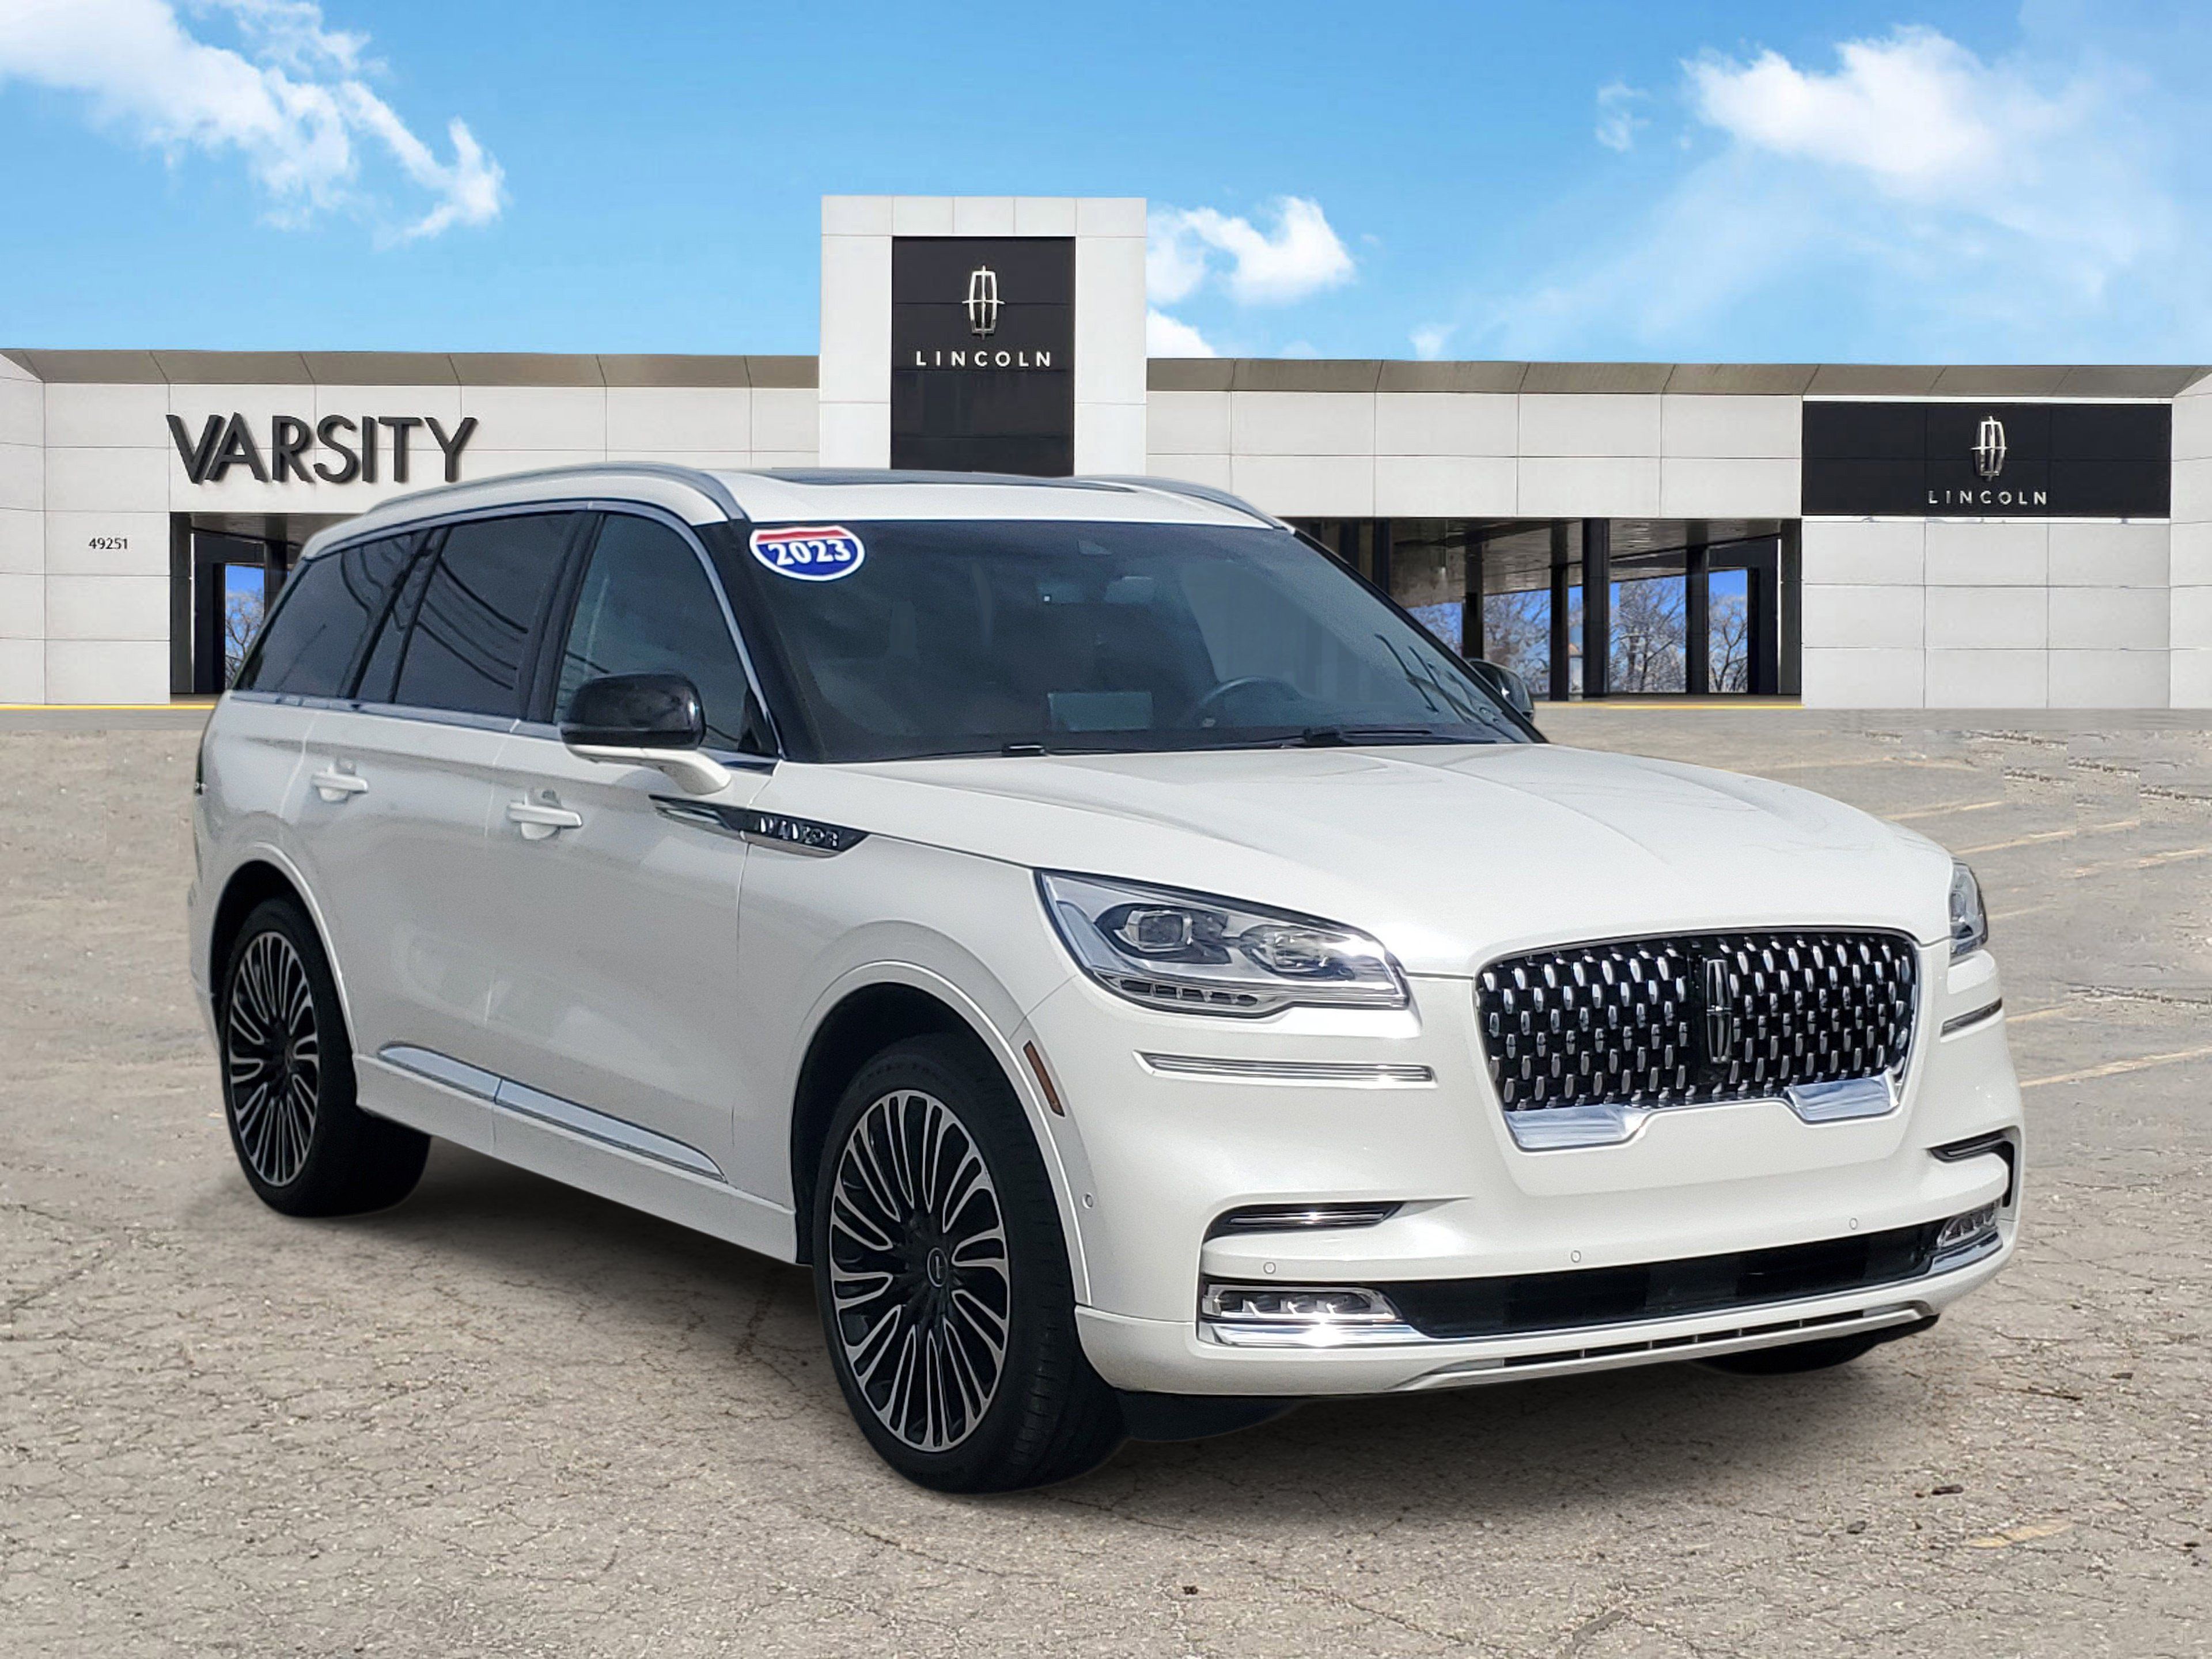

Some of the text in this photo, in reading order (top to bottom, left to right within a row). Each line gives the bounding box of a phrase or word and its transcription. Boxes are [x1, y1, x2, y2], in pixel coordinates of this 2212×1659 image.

[915, 350, 1051, 368] LINCOLN
[166, 412, 479, 485] VARSITY
[1927, 490, 2047, 506] LINCOLN
[89, 537, 128, 550] 49251
[767, 539, 852, 566] 2023
